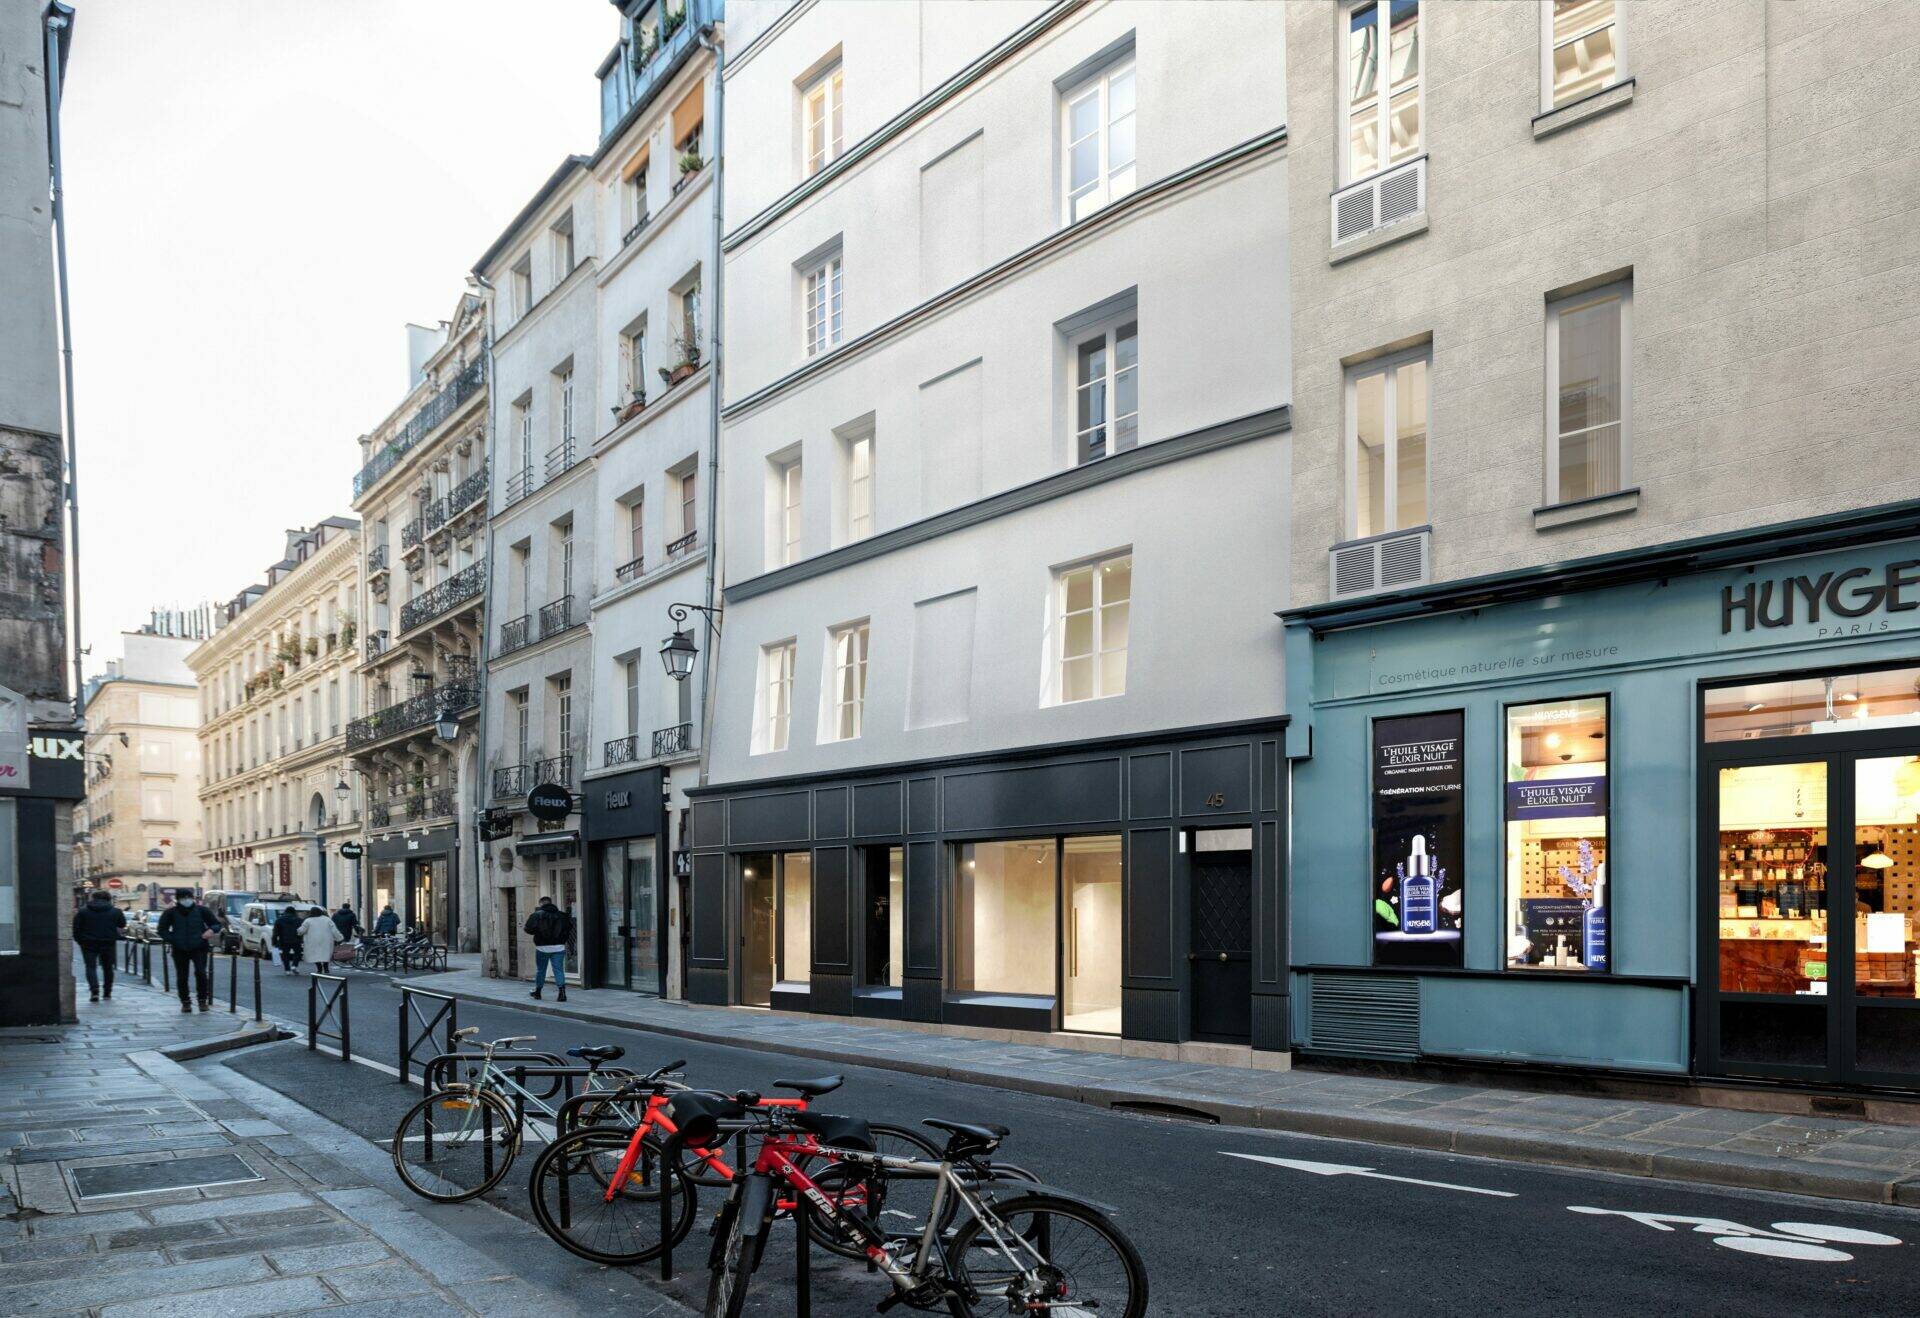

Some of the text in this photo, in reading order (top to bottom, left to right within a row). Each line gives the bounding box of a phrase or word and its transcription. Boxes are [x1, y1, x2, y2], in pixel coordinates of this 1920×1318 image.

[1721, 559, 1920, 635] HUYGE
[1818, 620, 1889, 638] PARIS
[1379, 646, 1618, 686] Cosmétique naturelle sur mesure
[1384, 742, 1454, 757] L'HUILE VISAGE
[1390, 751, 1447, 765] ÉLIXIR NUIT
[1384, 768, 1408, 776] ORGANIC
[1425, 783, 1462, 792] NOCTURNE
[1520, 786, 1593, 798] L'HUILE VISAGE
[1206, 793, 1225, 807] 45
[1527, 794, 1586, 806] ÉLIXIR NUIT
